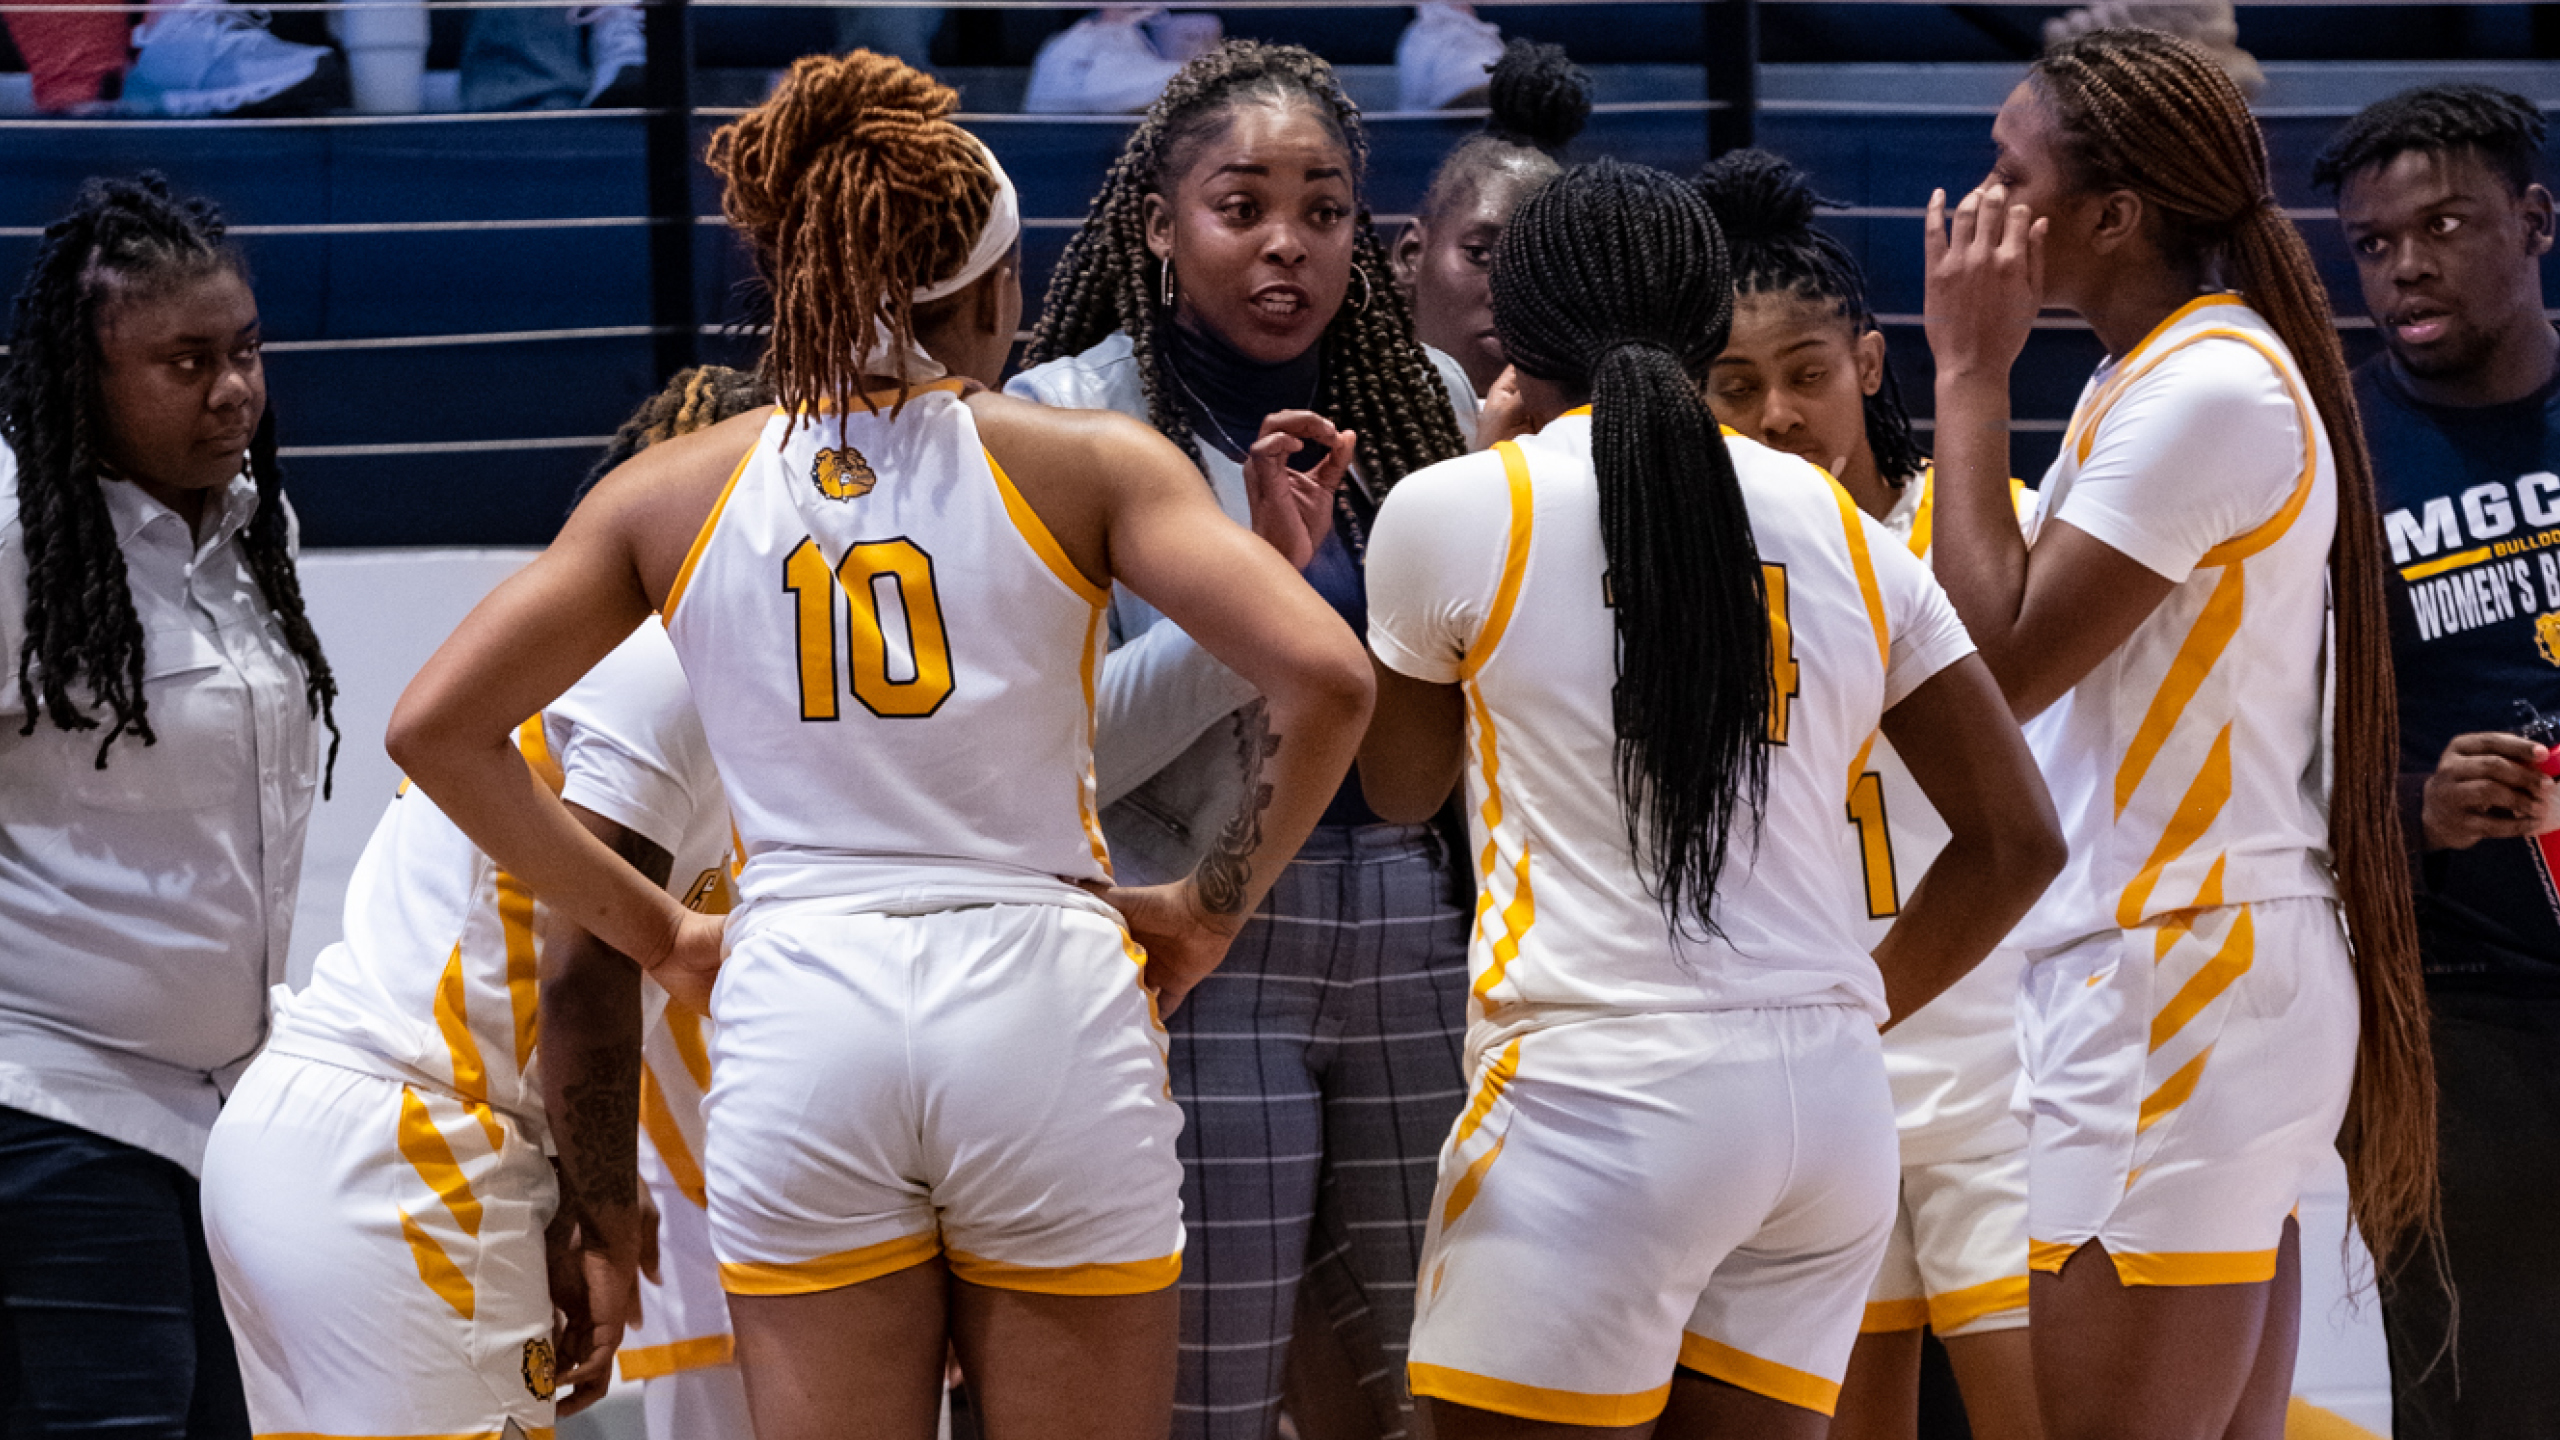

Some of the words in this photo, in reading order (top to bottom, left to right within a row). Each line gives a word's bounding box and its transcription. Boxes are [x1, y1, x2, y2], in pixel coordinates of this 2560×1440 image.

[2384, 471, 2560, 564] MGC
[782, 534, 956, 721] 10
[2409, 558, 2537, 641] WOMEN'S
[2538, 548, 2560, 608] B
